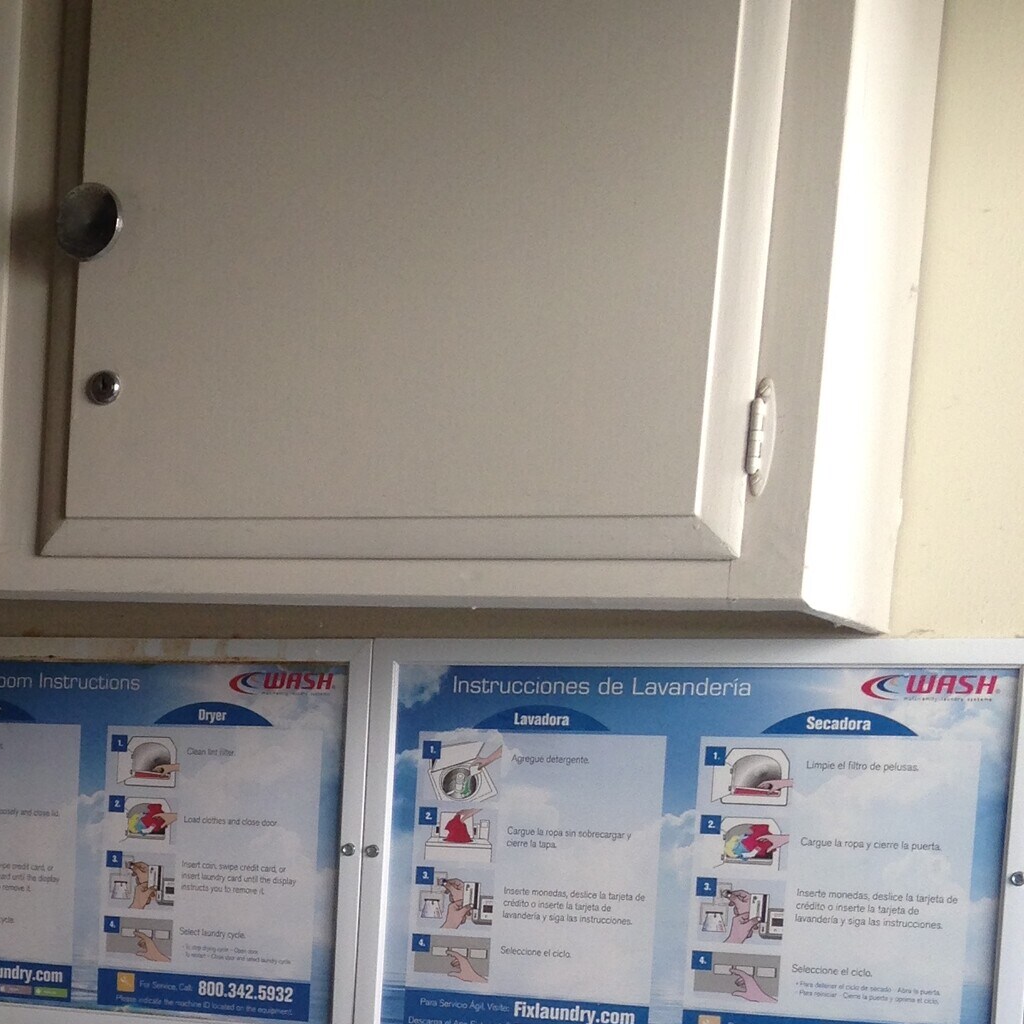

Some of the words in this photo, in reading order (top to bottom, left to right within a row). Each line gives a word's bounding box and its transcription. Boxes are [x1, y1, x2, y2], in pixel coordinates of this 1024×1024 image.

[39, 672, 141, 691] Instructions
[264, 672, 333, 690] WASH
[453, 676, 590, 695] Instrucciones
[599, 677, 623, 694] de
[632, 677, 751, 697] Lavandería
[906, 675, 998, 694] WASH
[198, 709, 226, 724] Dryer
[514, 713, 569, 726] Lavadora
[807, 716, 871, 731] Secadora
[187, 747, 206, 756] Clean
[713, 752, 720, 760] 1.
[512, 754, 544, 764] Agregue
[547, 755, 589, 765] detergente.
[807, 761, 835, 771] Limpie
[838, 762, 845, 770] el
[848, 761, 867, 771] filtro
[870, 762, 881, 771] de
[884, 762, 919, 772] pelusas.
[184, 817, 201, 825] Load
[202, 817, 226, 825] clothes
[229, 818, 240, 826] and
[242, 818, 260, 826] close
[708, 820, 716, 828] 2.
[507, 827, 535, 836] Cargue
[537, 828, 544, 836] la
[546, 829, 563, 838] ropa
[565, 829, 576, 837] sin
[579, 830, 624, 840] sobrecargar
[507, 839, 527, 848] cierre
[529, 839, 537, 848] la
[801, 837, 832, 848] Cargue
[835, 838, 842, 847] la
[845, 840, 864, 850] ropa
[866, 842, 870, 850] y
[873, 840, 898, 850] cierre
[901, 841, 908, 850] la
[911, 842, 941, 852] puerta.
[182, 861, 200, 869] Insert
[219, 863, 238, 874] swipe
[240, 864, 259, 872] credit
[182, 872, 200, 880] insert
[202, 874, 226, 884] laundry
[243, 875, 258, 883] until
[260, 876, 270, 884] the
[273, 877, 296, 887] display
[181, 883, 208, 892] instructs
[210, 886, 222, 895] you
[224, 885, 231, 893] to
[233, 886, 256, 894] remove
[504, 887, 530, 896] Inserte
[532, 889, 568, 899] monedas,
[570, 889, 597, 899] deslice
[600, 891, 606, 899] la
[608, 892, 633, 902] tarjeta
[636, 893, 645, 902] de
[797, 888, 826, 898] Inserte
[872, 892, 903, 902] deslice
[906, 893, 914, 902] la
[916, 894, 944, 905] tarjeta
[947, 896, 958, 904] de
[503, 899, 529, 908] crédito
[538, 901, 564, 910] inserte
[566, 902, 572, 910] la
[575, 903, 599, 913] tarjeta
[602, 903, 611, 912] de
[796, 902, 825, 911] crédito
[836, 904, 865, 912] inserte
[868, 904, 875, 913] la
[878, 905, 906, 916] tarjeta
[908, 906, 919, 915] de
[503, 911, 540, 920] lavandería
[549, 913, 565, 923] siga
[567, 913, 577, 922] las
[580, 914, 632, 925] instrucciones.
[795, 914, 838, 924] lavandería
[840, 918, 846, 926] y
[848, 917, 866, 927] siga
[868, 918, 880, 926] las
[883, 918, 942, 930] instrucciones.
[179, 928, 199, 936] Select
[202, 929, 226, 939] laundry
[228, 930, 246, 940] cycle.
[501, 946, 541, 957] Seleccione
[544, 949, 551, 957] el
[553, 949, 571, 958] ciclo.
[700, 956, 706, 964] 4.
[792, 964, 838, 975] Seleccione
[841, 967, 848, 976] el
[851, 968, 872, 978] ciclo.
[140, 980, 150, 989] For
[198, 980, 293, 1002] 800.342.5932
